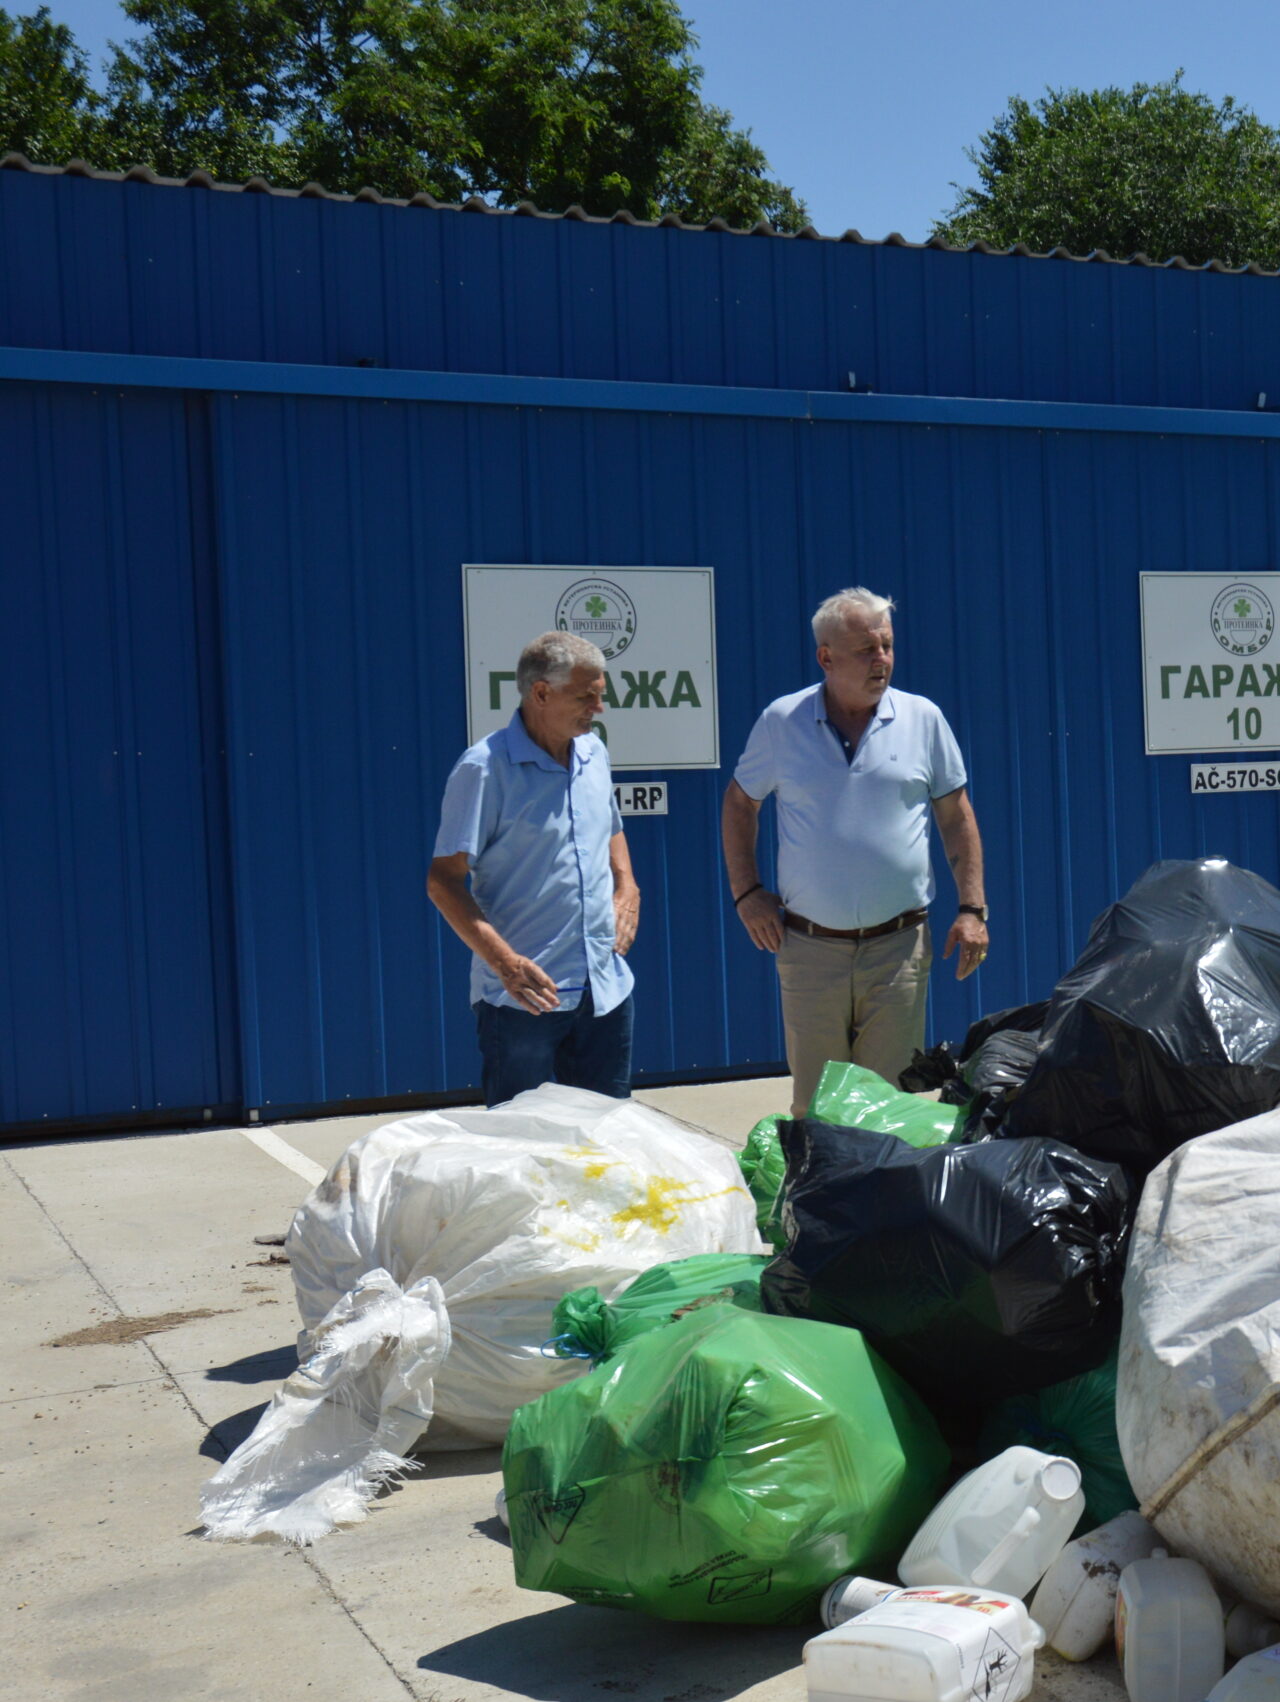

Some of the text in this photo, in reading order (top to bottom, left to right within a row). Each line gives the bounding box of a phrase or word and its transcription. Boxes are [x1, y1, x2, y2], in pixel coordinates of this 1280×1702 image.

[559, 617, 633, 657] СБОР
[1213, 617, 1272, 653] СОМБОР
[489, 670, 702, 710] ГАЖА
[1226, 707, 1262, 740] 10
[614, 786, 662, 810] 1-RP
